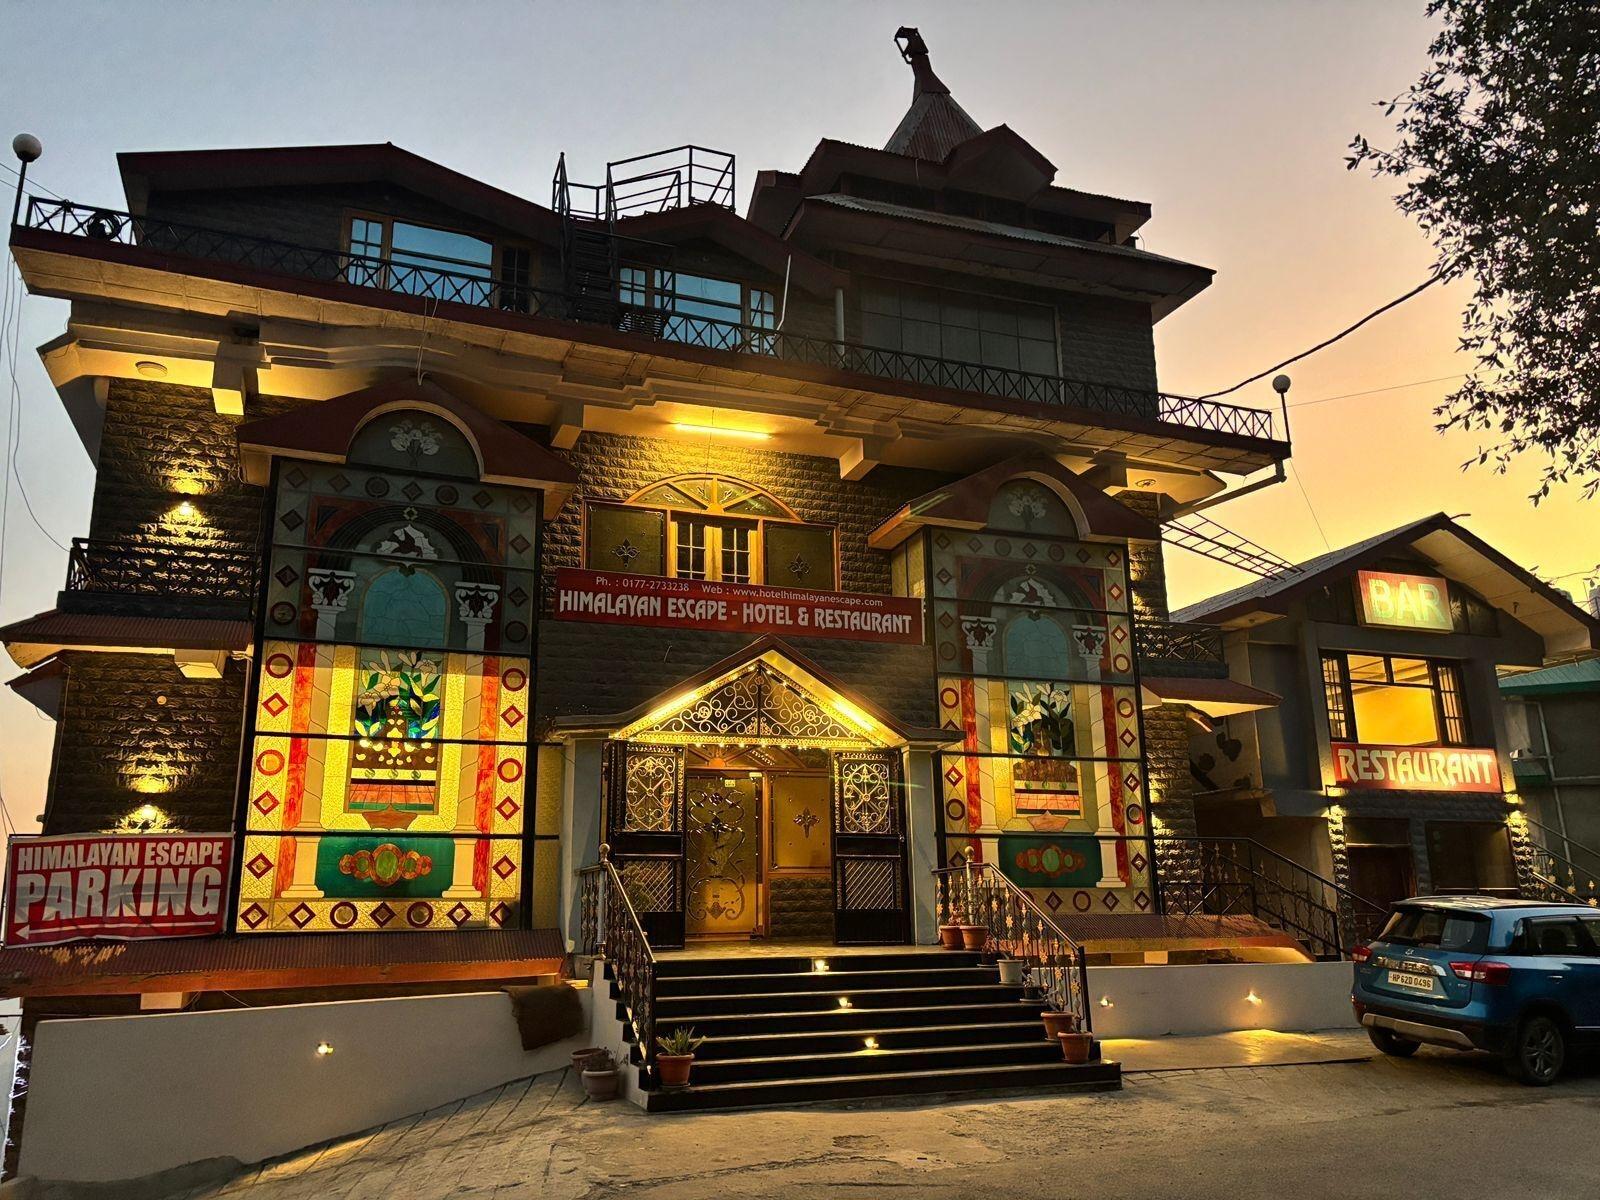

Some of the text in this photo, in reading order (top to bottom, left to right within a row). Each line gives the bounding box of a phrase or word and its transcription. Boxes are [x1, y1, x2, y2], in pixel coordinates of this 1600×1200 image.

[559, 589, 661, 617] HIMALAYAN
[667, 597, 728, 621] ESCAPE
[742, 602, 793, 625] HOTEL
[797, 606, 809, 626] &
[814, 608, 912, 634] RESTAURANT
[622, 578, 690, 592] 0177-2733238
[702, 584, 723, 595] Web
[733, 588, 883, 608] www.hotelhimalayanescape.com
[1368, 578, 1447, 622] BAR
[1338, 748, 1494, 787] RESTAURANT
[18, 841, 224, 871] HIMALAYAN ESCAPE
[14, 866, 222, 924] PARKING
[1392, 973, 1401, 983] HP
